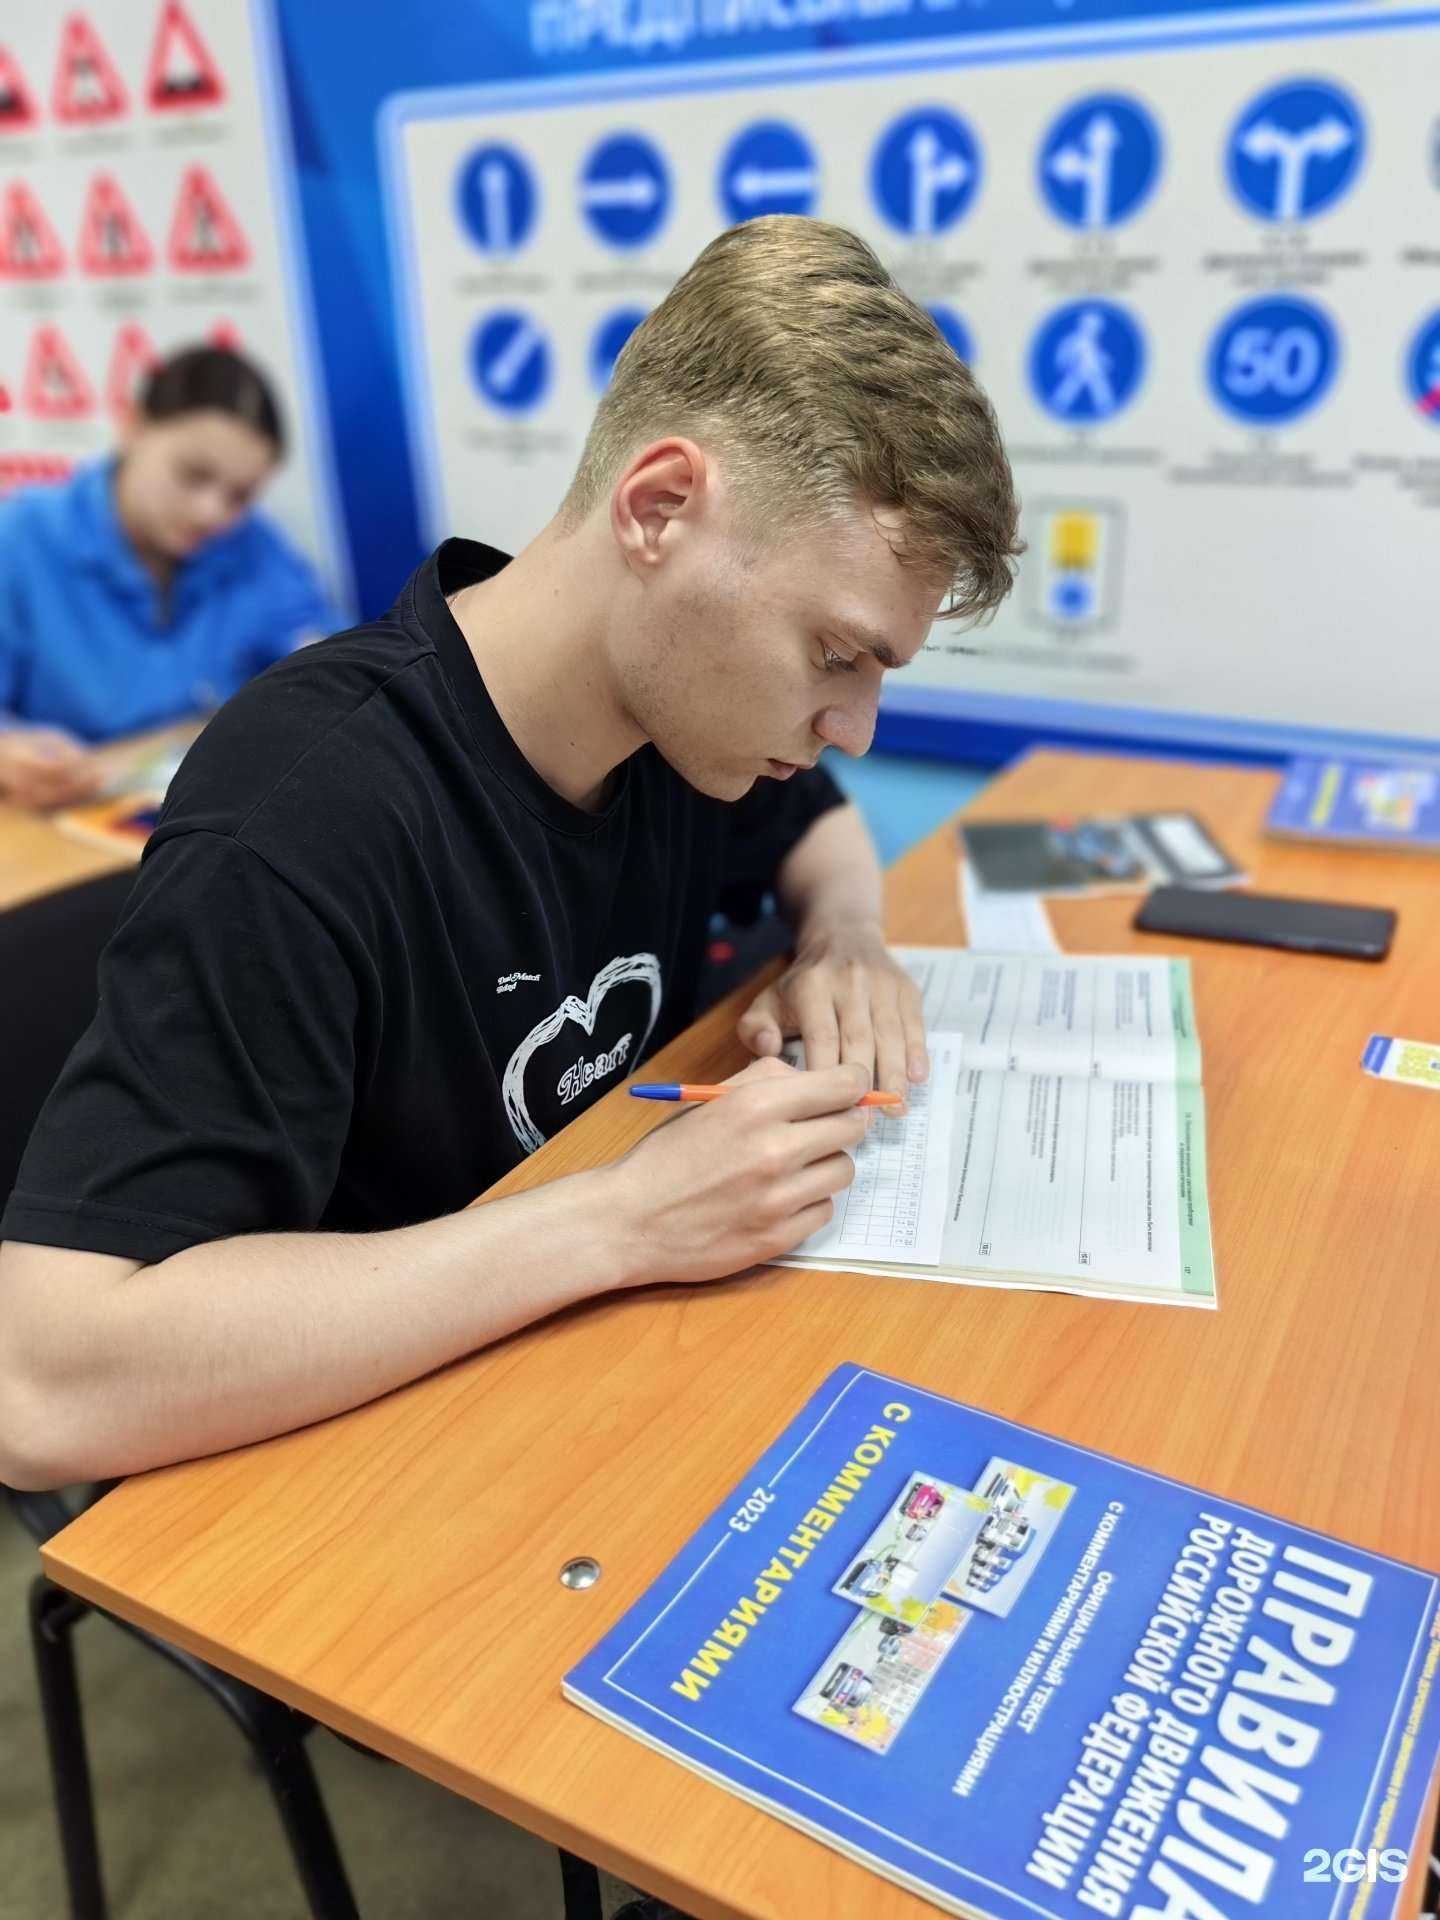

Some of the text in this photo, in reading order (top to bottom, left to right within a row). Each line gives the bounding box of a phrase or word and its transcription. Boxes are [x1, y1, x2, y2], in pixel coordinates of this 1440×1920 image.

[1223, 326, 1321, 397] 50
[670, 1402, 912, 1702] С КОММЕНТАРИЯМИ
[728, 1487, 776, 1533] 2023
[952, 1500, 1125, 1798] С КОММЕНТАРИЯМИ И ИЛЛЮСТРАЦИЯМИ
[1017, 1570, 1114, 1733] ОФИЦИАЛЬНЫЙ ТЕКСТ
[1026, 1512, 1233, 1891] РОССИЙСКОЙ ФЕДЕРАЦИИ
[1076, 1526, 1276, 1918] ДОРОЖНОГО ДВИЖЕНИЯ
[1129, 1545, 1374, 1920] ПРАВИЛА
